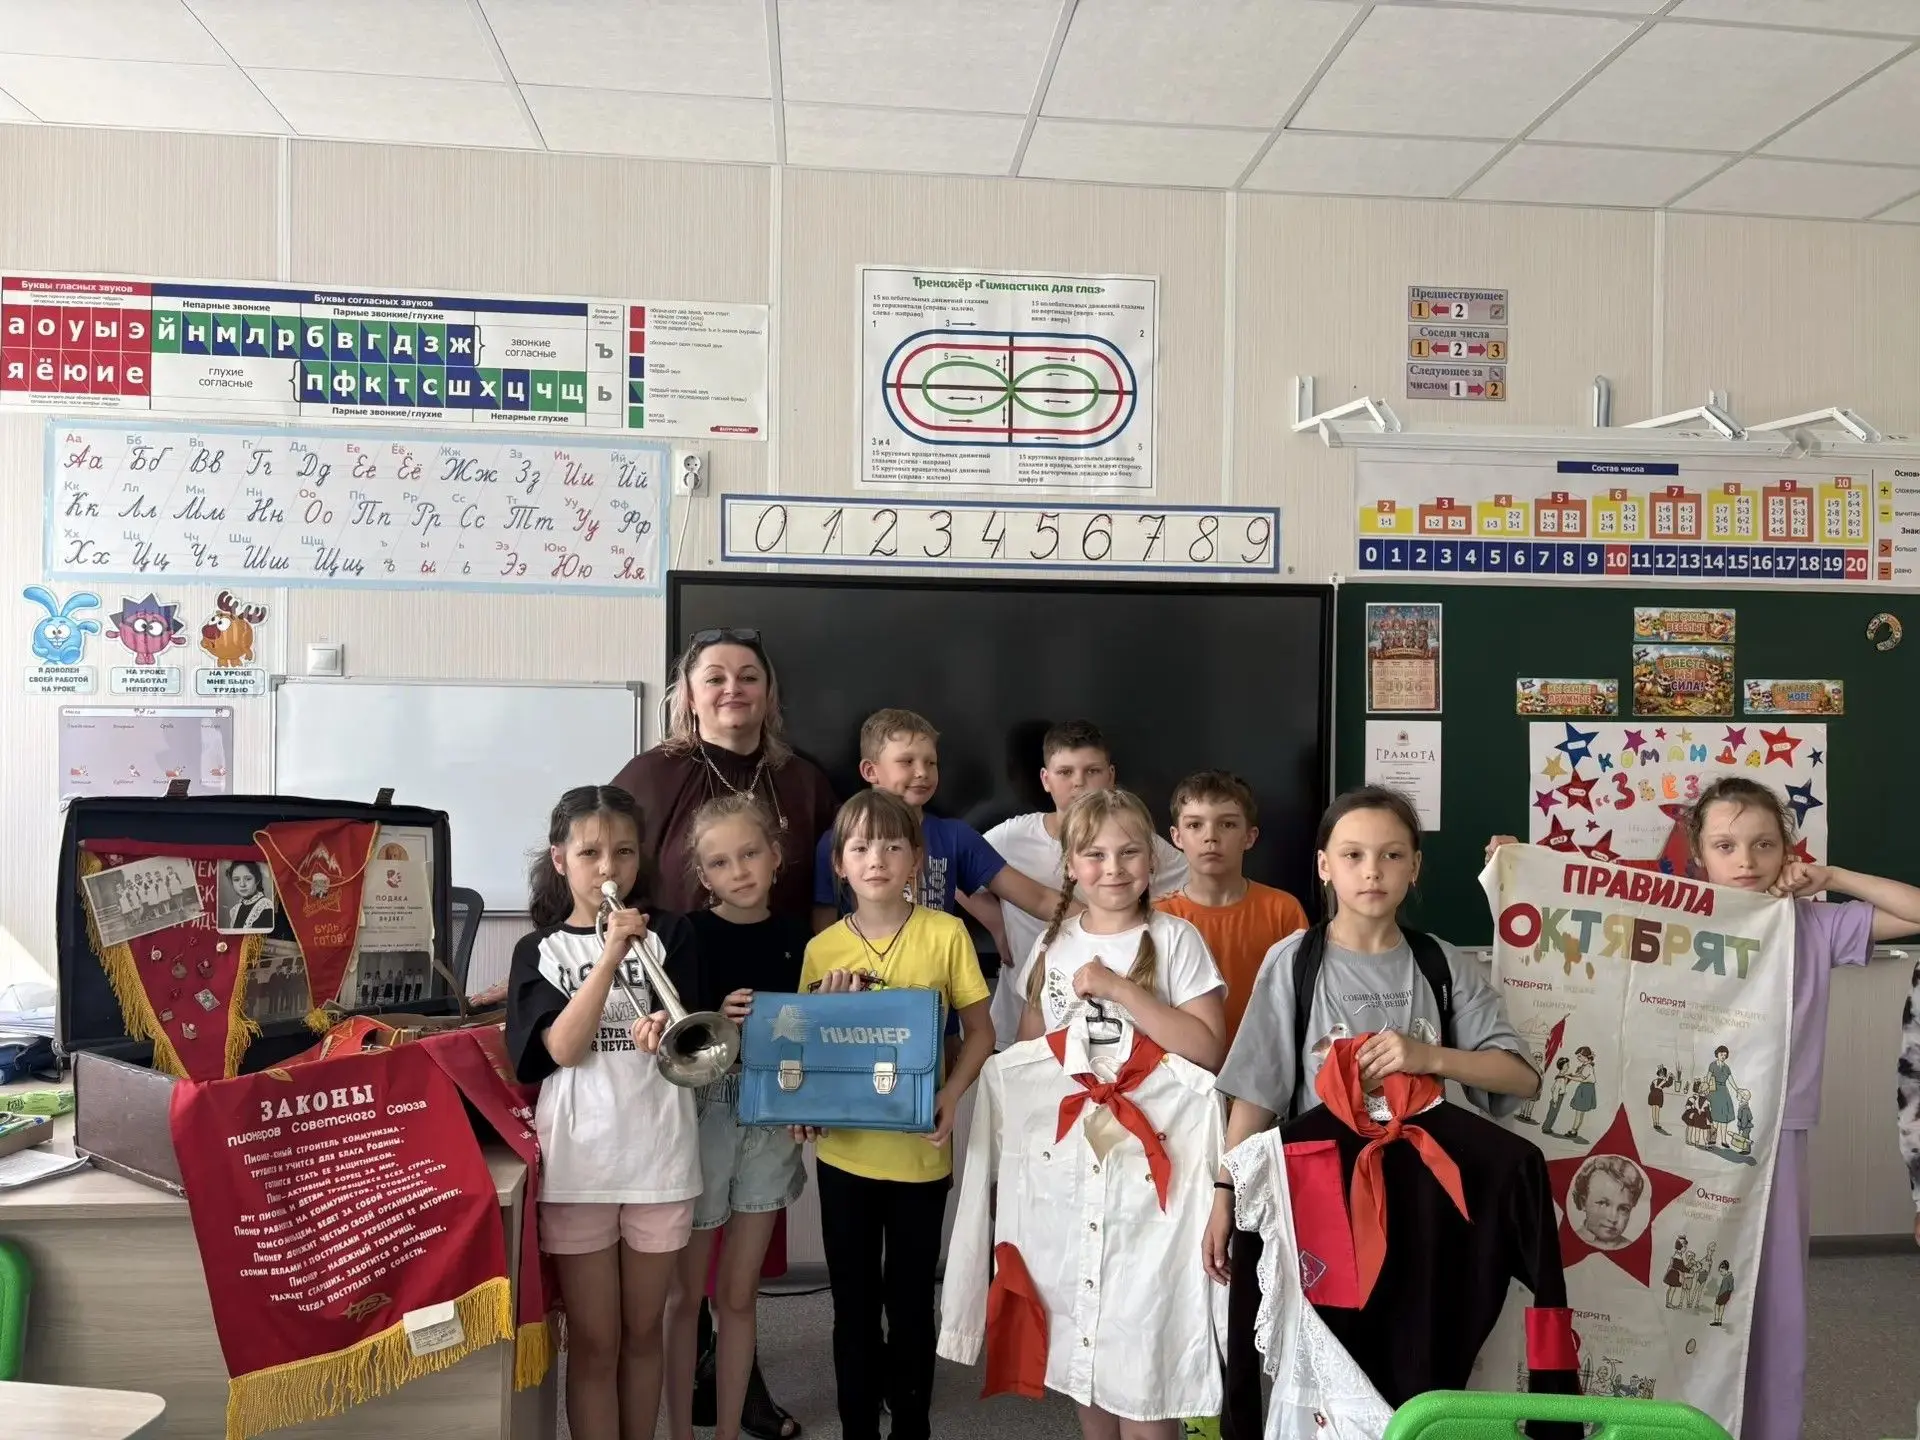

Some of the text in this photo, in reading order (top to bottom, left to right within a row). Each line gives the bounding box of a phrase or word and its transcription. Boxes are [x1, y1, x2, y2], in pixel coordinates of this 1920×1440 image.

[22, 280, 133, 293] Буквы гласных звуков
[913, 277, 1105, 294] Тренажёр «Гимнастика для глаз»
[314, 294, 433, 308] Буквы согласных звуков
[1412, 288, 1504, 301] Предшествующее
[183, 300, 271, 312] Непарные звонкие
[1417, 303, 1464, 318] 1 2
[334, 308, 444, 321] Парные звонкие/глухие
[1420, 327, 1490, 339] Соседи числа
[511, 338, 551, 348] звонкие
[506, 348, 557, 359] согласные
[1417, 342, 1500, 358] 1 2 3
[209, 368, 244, 377] глухие
[1410, 365, 1483, 378] Следующее за
[199, 378, 253, 388] согласные
[1410, 382, 1448, 390] числом
[1455, 382, 1499, 396] 1 2
[332, 407, 443, 419] Парные звонкие/глухие
[491, 412, 569, 423] Непарные глухие
[1592, 464, 1619, 473] Состав
[755, 505, 1271, 564] 0 1 2 3 4 5 6 7 8 9
[1366, 548, 1627, 567] 0 1 2 3 4 5 6 7 8 9 10
[1663, 658, 1706, 670] ВМЕСТЕ
[1671, 681, 1704, 692] СИЛА!
[1376, 748, 1436, 761] ГРАМОТА
[1562, 864, 1715, 917] ПРАВИЛА
[1498, 902, 1761, 980] ОКТЯБРЯТ
[820, 1026, 911, 1045] ПИОНЕР
[260, 1084, 375, 1122] ЗАКОНЫ
[227, 1099, 427, 1148] пионеров Советского Союза
[296, 1126, 400, 1155] СТРОИТЕЛЬ КОММУНИЗМА
[318, 1153, 336, 1164] ДЛЯ
[338, 1147, 364, 1159] БЛАГА
[296, 1171, 319, 1183] СТАТЬ
[322, 1167, 332, 1176] ЕЕ
[364, 1168, 376, 1176] ЗА
[424, 1163, 447, 1175] СТАТЬ
[341, 1207, 353, 1217] ЗА
[355, 1192, 383, 1211] СОБОЙ
[350, 1210, 375, 1228] СВОЕЙ
[407, 1208, 417, 1217] ЕЕ
[374, 1267, 386, 1278] ПО
[270, 1292, 304, 1302] УВАЖАЕТ
